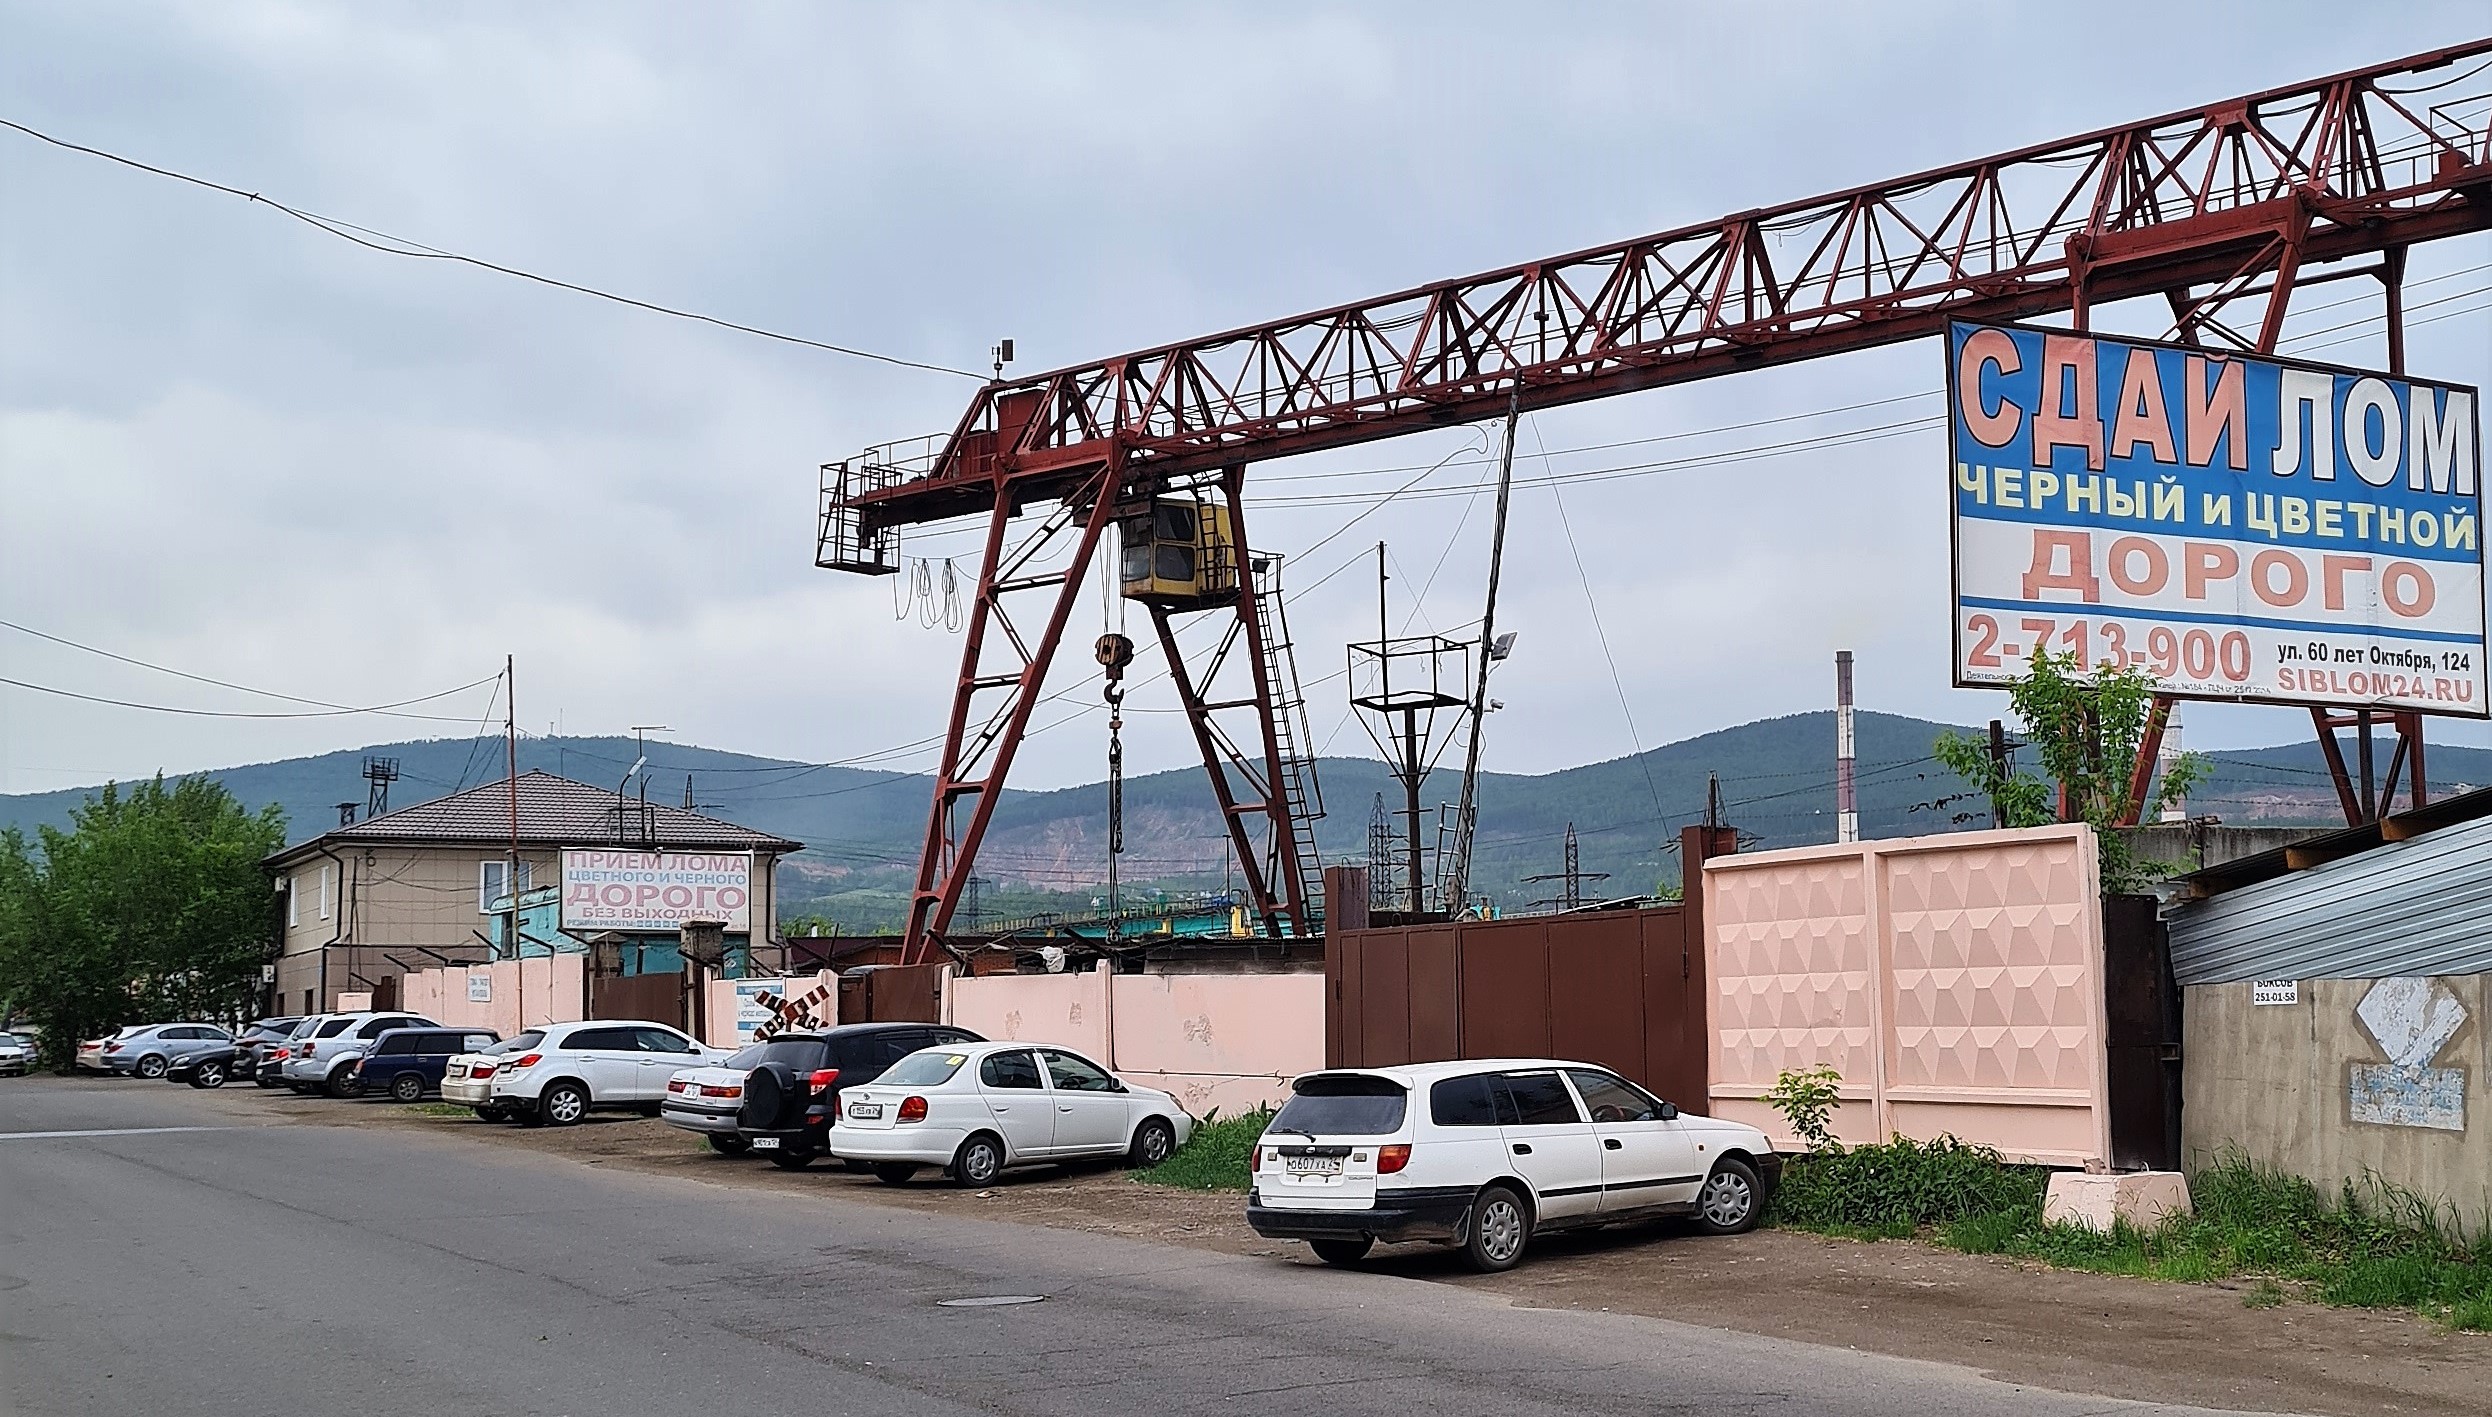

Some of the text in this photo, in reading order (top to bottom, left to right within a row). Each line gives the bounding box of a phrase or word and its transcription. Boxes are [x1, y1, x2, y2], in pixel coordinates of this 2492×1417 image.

[1959, 328, 2475, 496] СДАЙ ЛОМ
[1958, 462, 2185, 524] ЧЕРНЫЙ
[2246, 493, 2476, 551] ЦВЕТНОЙ
[2022, 528, 2436, 618] ДОРОГО
[1967, 614, 2252, 682] 2-713-900
[2278, 642, 2470, 673] ул. 60 лет Октября, 124
[2278, 667, 2473, 702] SIBLOM24.RU
[568, 870, 747, 885] ЦВЕТНОГО И ЧЕРНОГО
[569, 851, 747, 872] ПРИЕМ ЛОМА
[567, 883, 746, 909] ДОРОГО
[582, 907, 733, 920] БЕЗ ВЫХОДНЫХ
